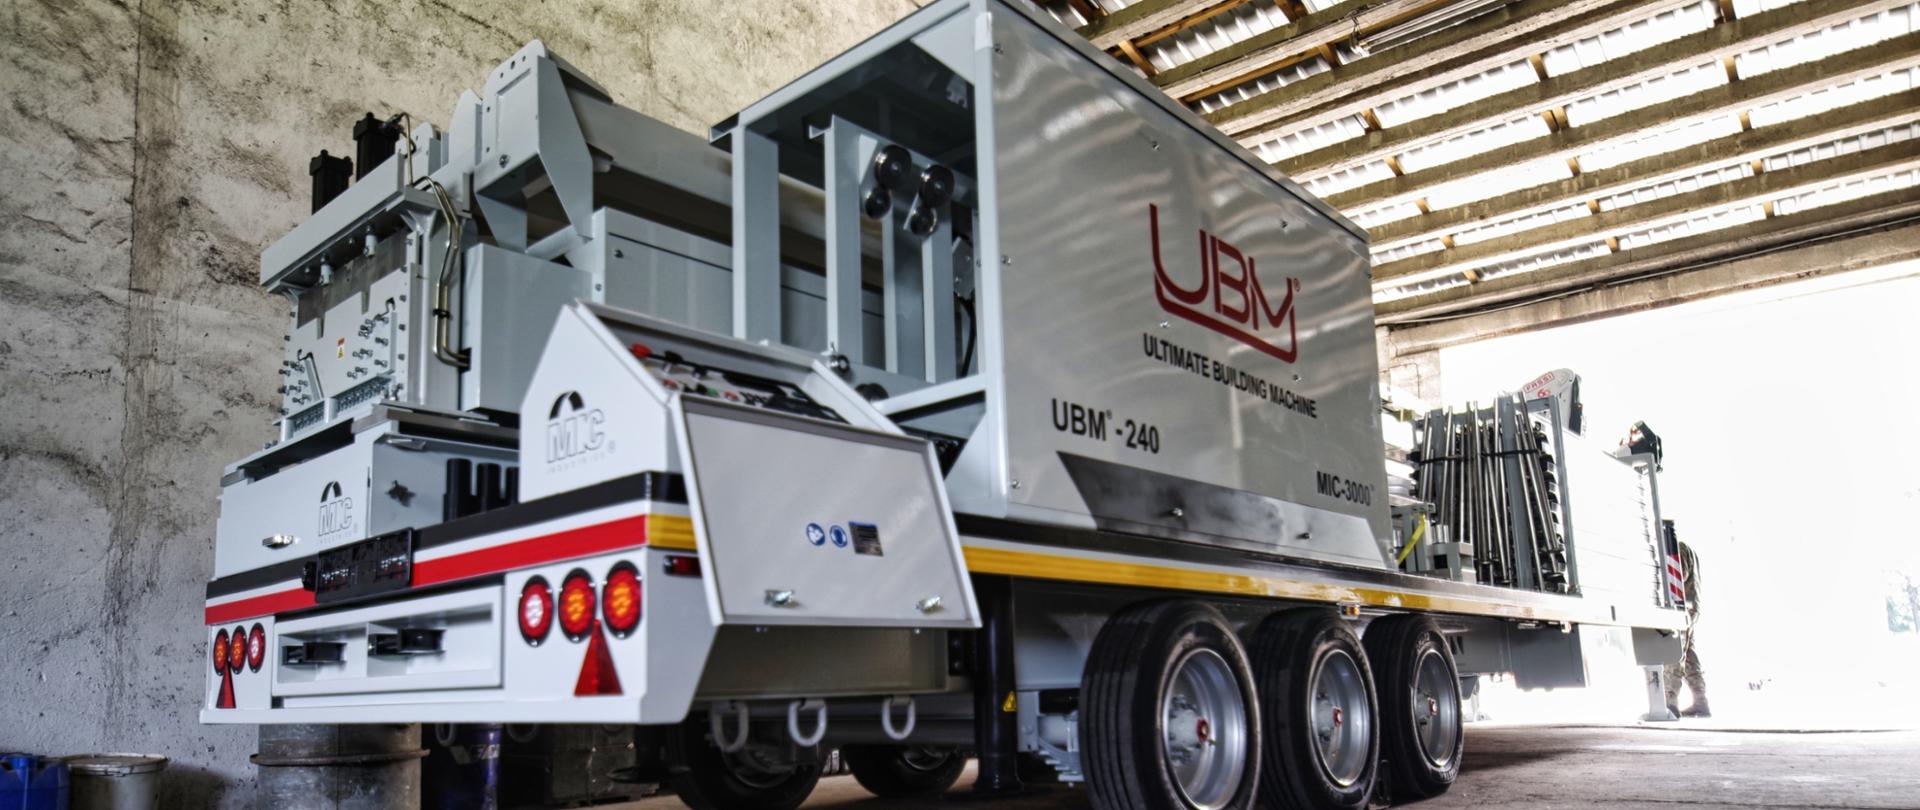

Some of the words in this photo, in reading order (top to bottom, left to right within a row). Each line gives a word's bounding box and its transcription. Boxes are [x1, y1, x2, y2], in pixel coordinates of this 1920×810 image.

[1143, 333, 1210, 378] ULTIMATE
[1212, 360, 1267, 399] BUILDING
[1269, 383, 1317, 419] MACHINE
[546, 408, 605, 463] MIC
[318, 496, 353, 537] MIC
